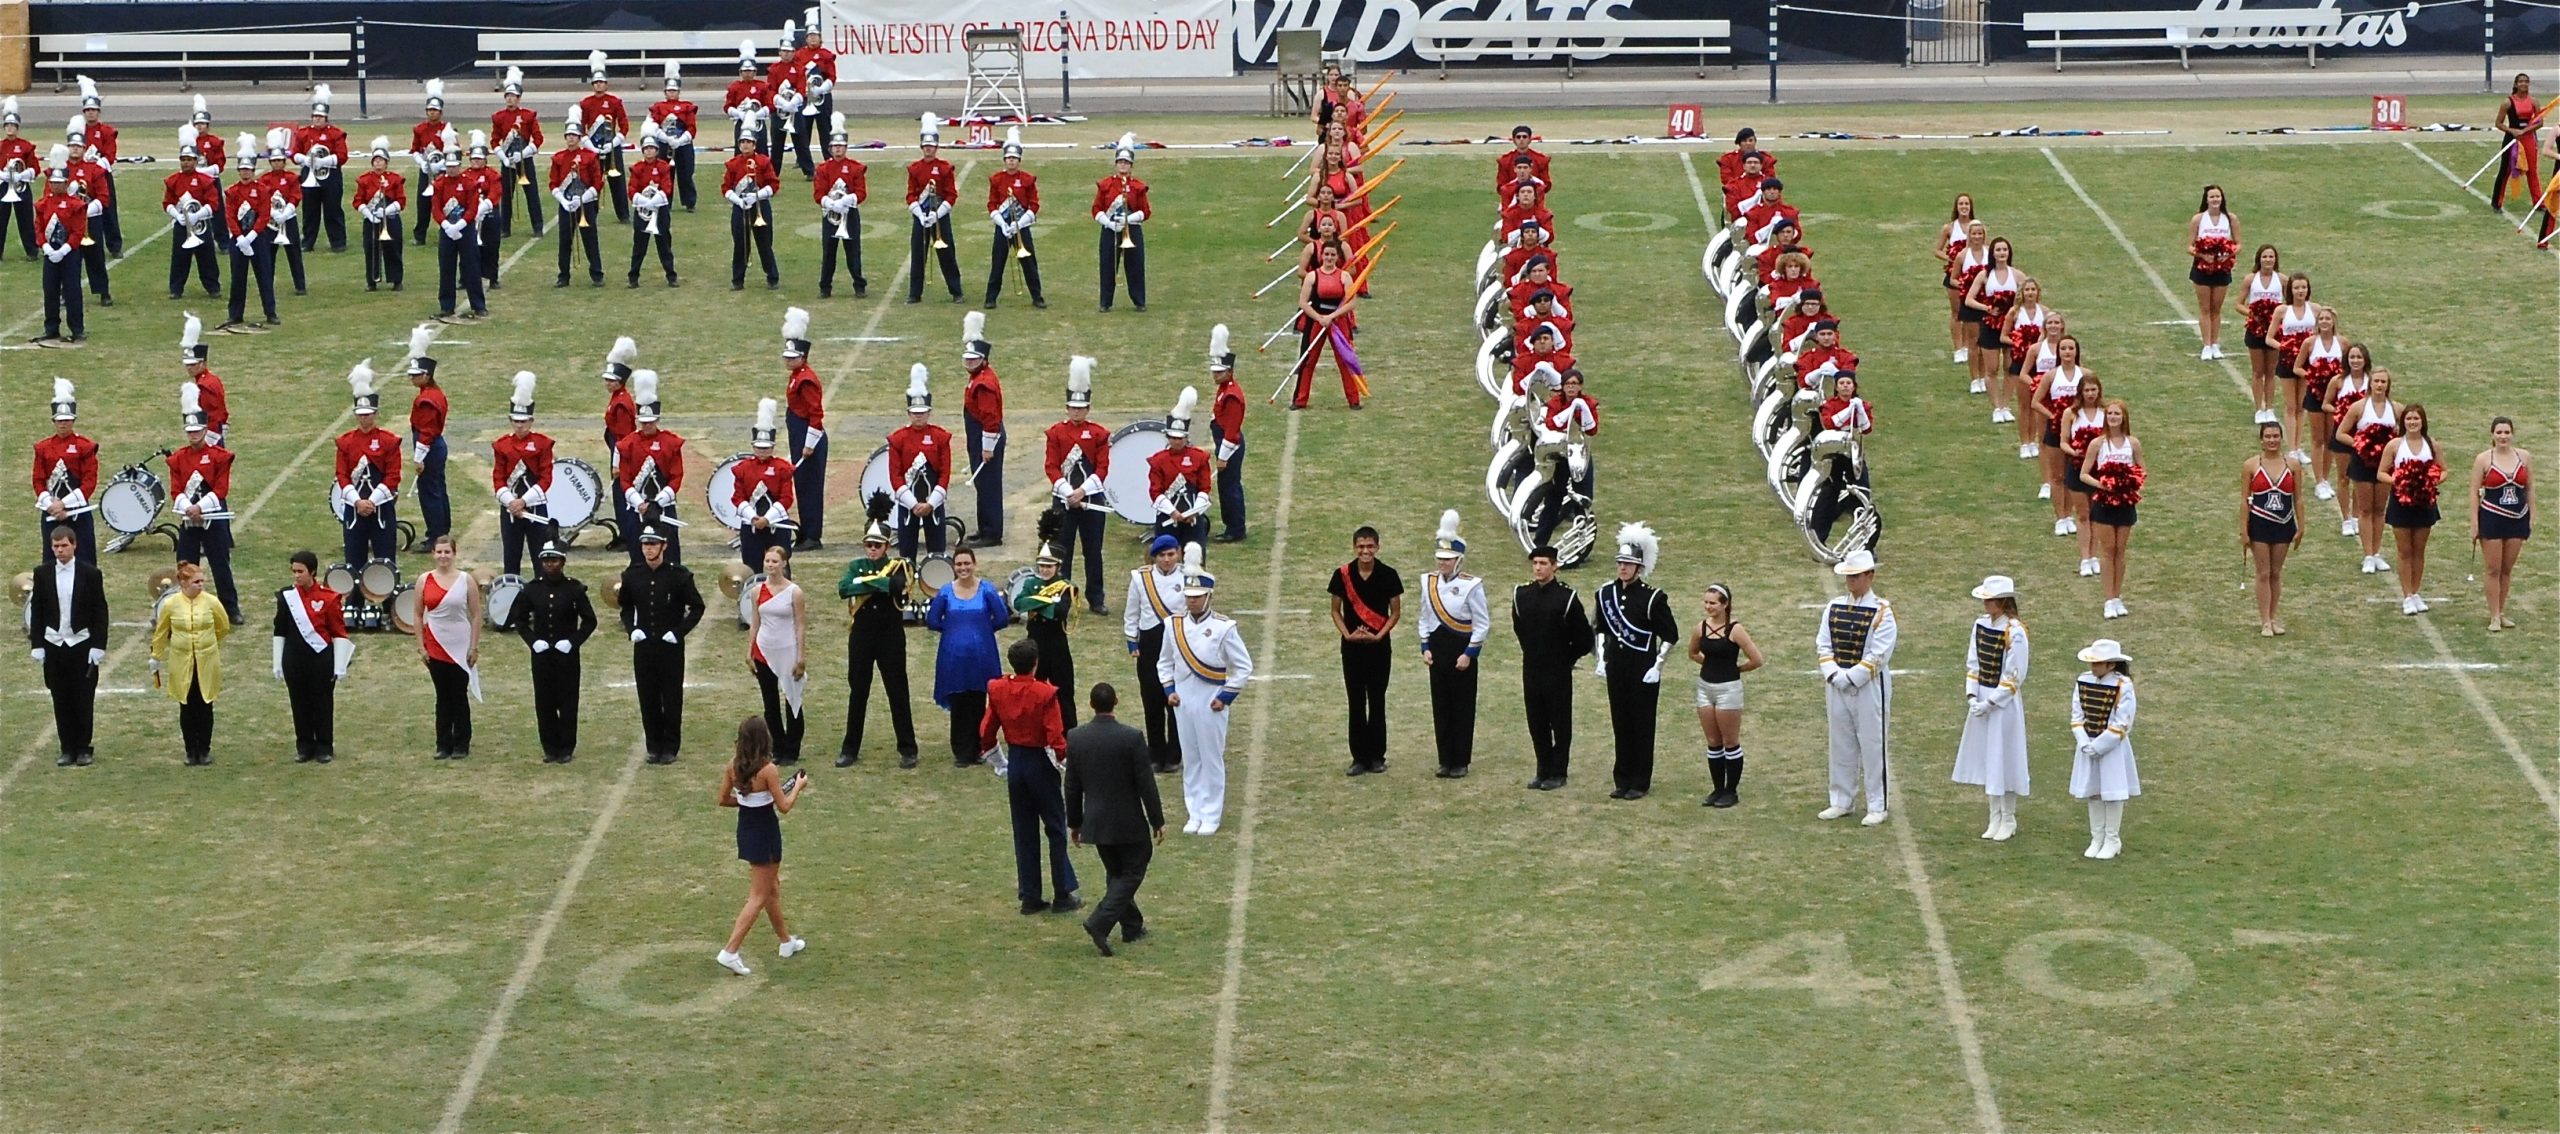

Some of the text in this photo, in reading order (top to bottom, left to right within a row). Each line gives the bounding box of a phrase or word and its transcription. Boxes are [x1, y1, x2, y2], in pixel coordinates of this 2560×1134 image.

[833, 23, 955, 56] UNIVERSITY
[998, 20, 1099, 52] ARIZONA
[1105, 20, 1168, 52] BAND
[1176, 19, 1220, 50] DAY
[1670, 109, 1695, 132] 40
[2377, 99, 2401, 123] 30
[970, 125, 991, 144] 50
[569, 473, 591, 503] YAMAHA
[134, 491, 152, 514] YAMAHA
